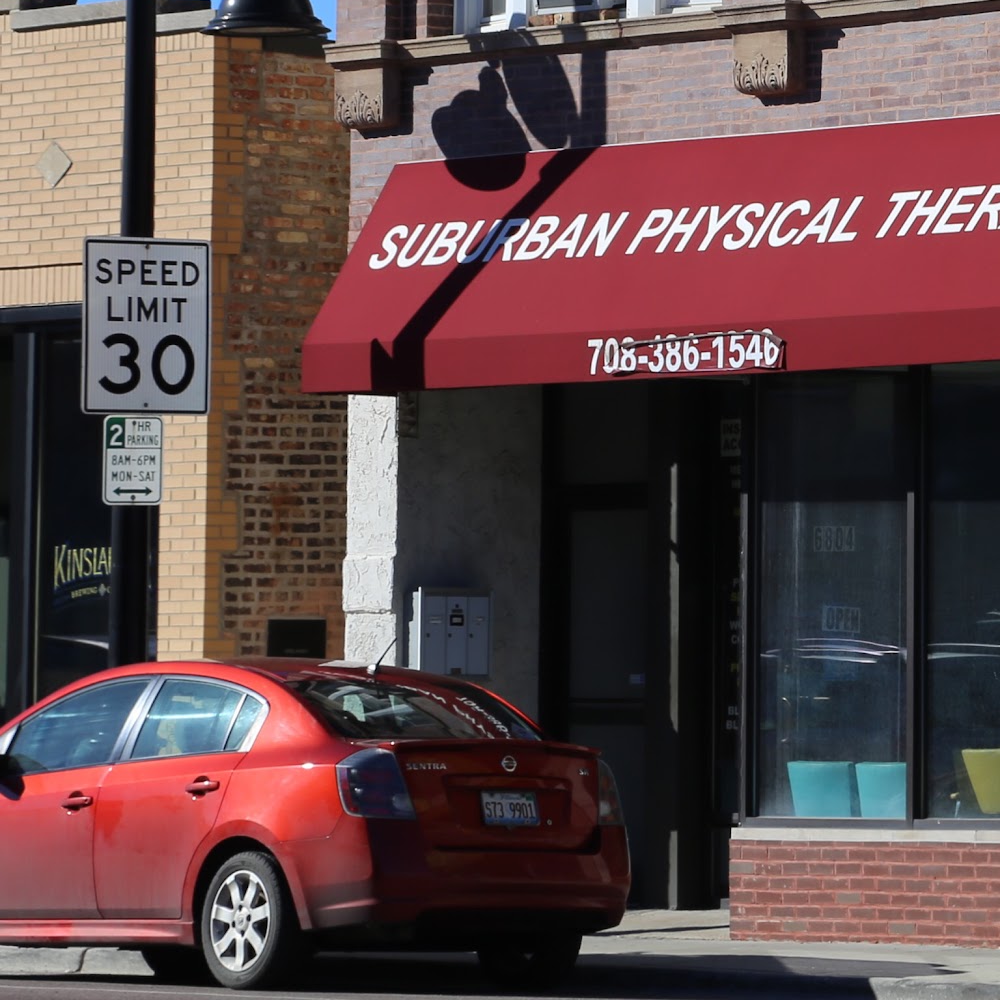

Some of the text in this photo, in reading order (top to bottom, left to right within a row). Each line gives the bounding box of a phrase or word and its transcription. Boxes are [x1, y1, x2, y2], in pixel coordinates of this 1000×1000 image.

[369, 210, 629, 270] SUBURBAN
[625, 196, 864, 255] PHYSICAL
[95, 258, 200, 287] SPEED
[106, 297, 188, 323] LIMIT
[99, 333, 196, 395] 30
[110, 421, 151, 446] 2 HR
[127, 434, 159, 446] PARKING
[723, 423, 740, 434] INS
[111, 454, 156, 466] 8AM-6PM
[111, 471, 156, 482] MON-SAT
[815, 526, 854, 551] 6804
[826, 607, 859, 630] OPEN
[405, 762, 447, 770] SENTRA
[509, 802, 536, 819] 9901
